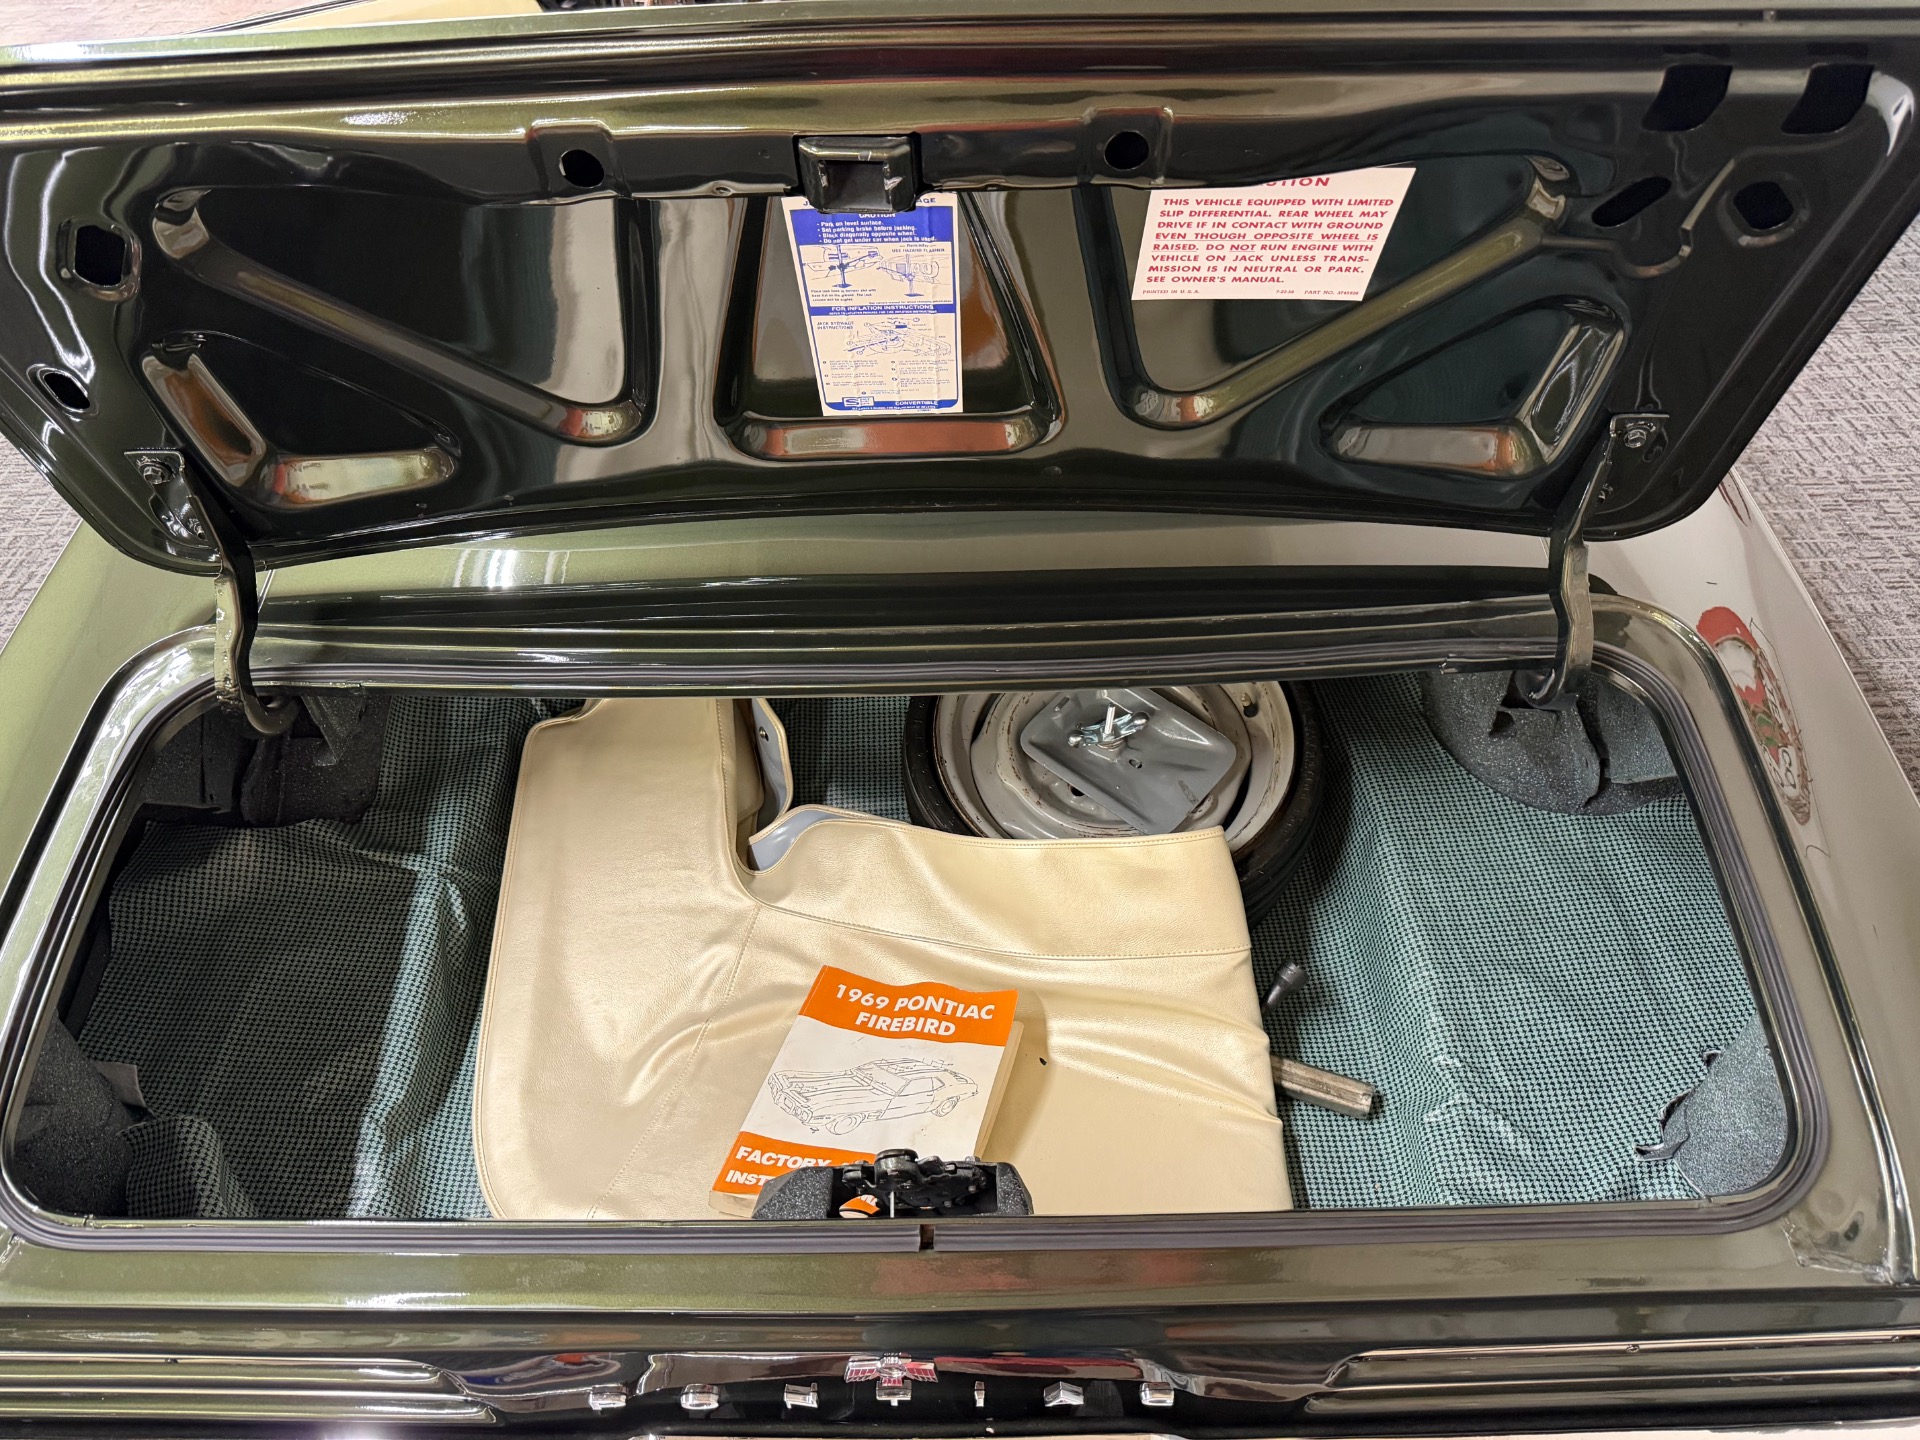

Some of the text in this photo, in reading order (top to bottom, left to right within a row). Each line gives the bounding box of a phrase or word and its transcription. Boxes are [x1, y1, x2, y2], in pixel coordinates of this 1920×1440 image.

[1163, 198, 1394, 206] THIS VEHICLE EQUIPPED WITH LIMITED
[1159, 210, 1389, 218] SLIP DIFFERENTIAL. REAR WHEEL MAY
[1157, 221, 1384, 229] DRIVE IF IN CONTACT WITH GROUND
[1155, 232, 1379, 240] EVEN THOUGH OPPOSITE WHEEL IS
[1153, 243, 1373, 251] RAISED. DO NOT RUN ENGINE WITH
[1148, 265, 1364, 273] MISSION IS IN NEUTRAL OR PARK.
[836, 983, 996, 1021] 1969 PONTIAC
[855, 1011, 956, 1037] FIREBIRD
